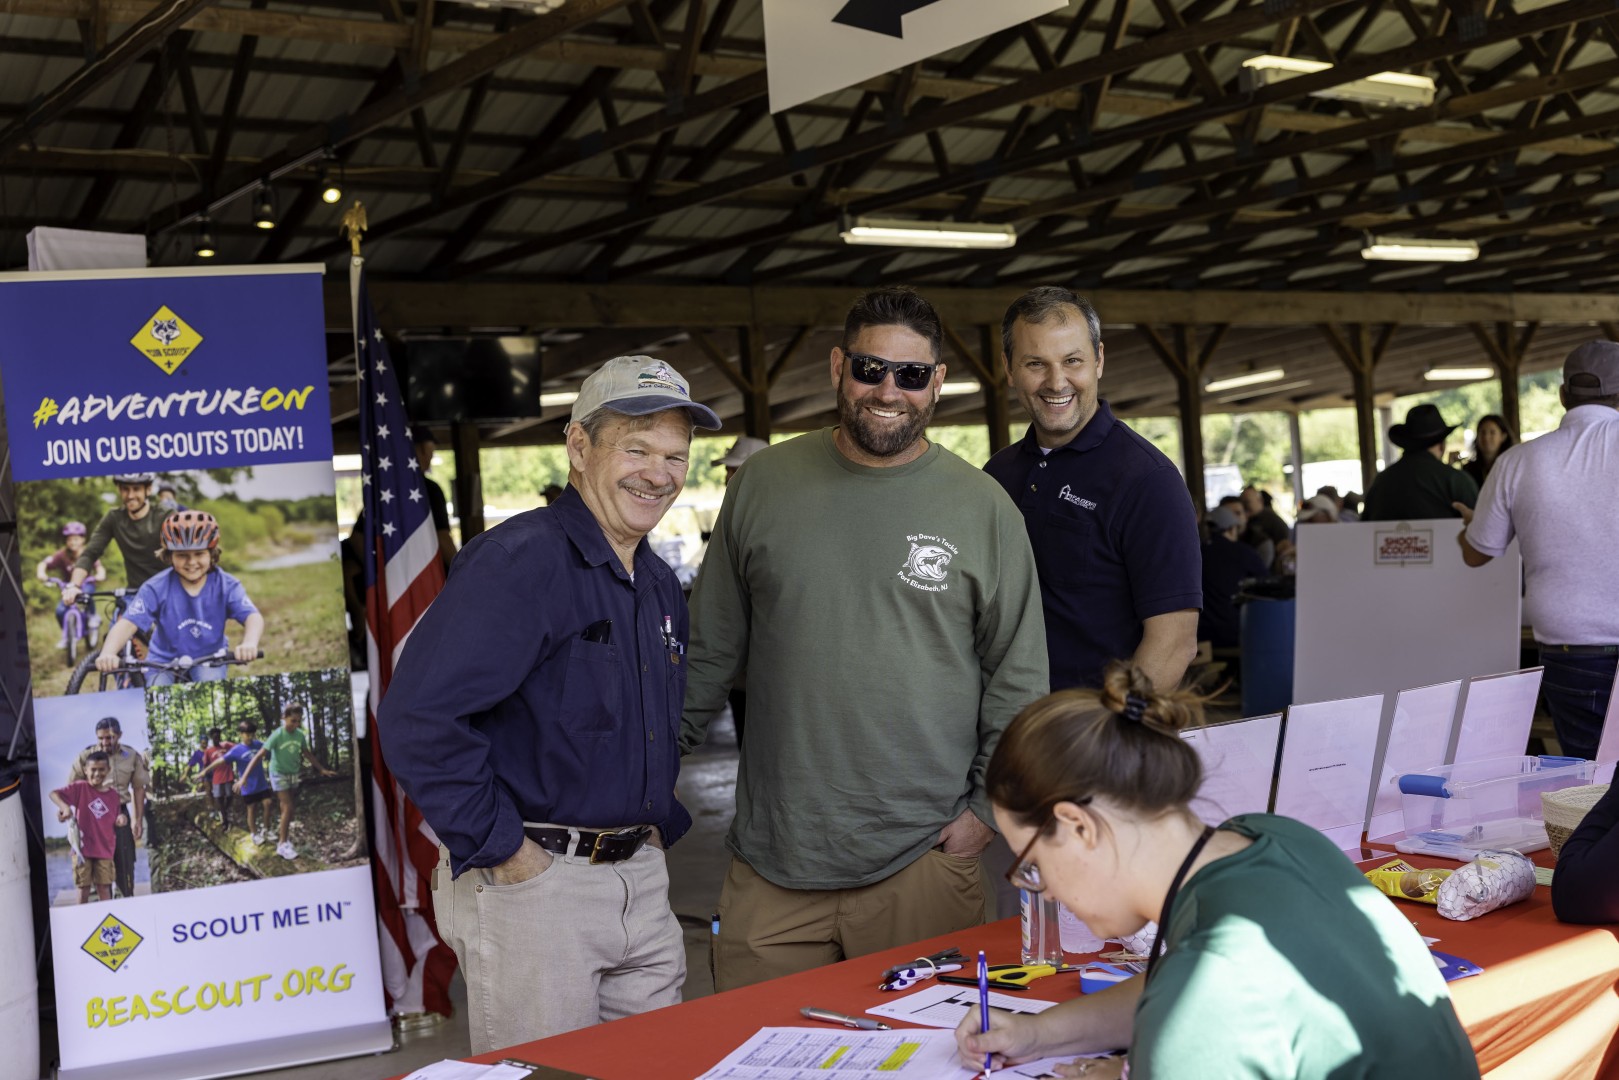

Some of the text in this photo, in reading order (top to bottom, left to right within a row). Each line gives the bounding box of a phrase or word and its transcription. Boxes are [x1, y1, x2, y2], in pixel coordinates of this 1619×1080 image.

[33, 385, 314, 430] #ADVENTUREON
[42, 426, 304, 466] JOIN CUB SCOUTS TODAY!
[906, 533, 959, 555] Big Dave's Tackle
[1380, 545, 1429, 555] SCOUTING
[1385, 537, 1418, 546] SHOOT
[897, 571, 948, 592] Port Elizabeth, NJ
[172, 911, 265, 944] SCOUT
[273, 905, 310, 929] ME
[86, 963, 355, 1030] BEASCOUT.ORG
